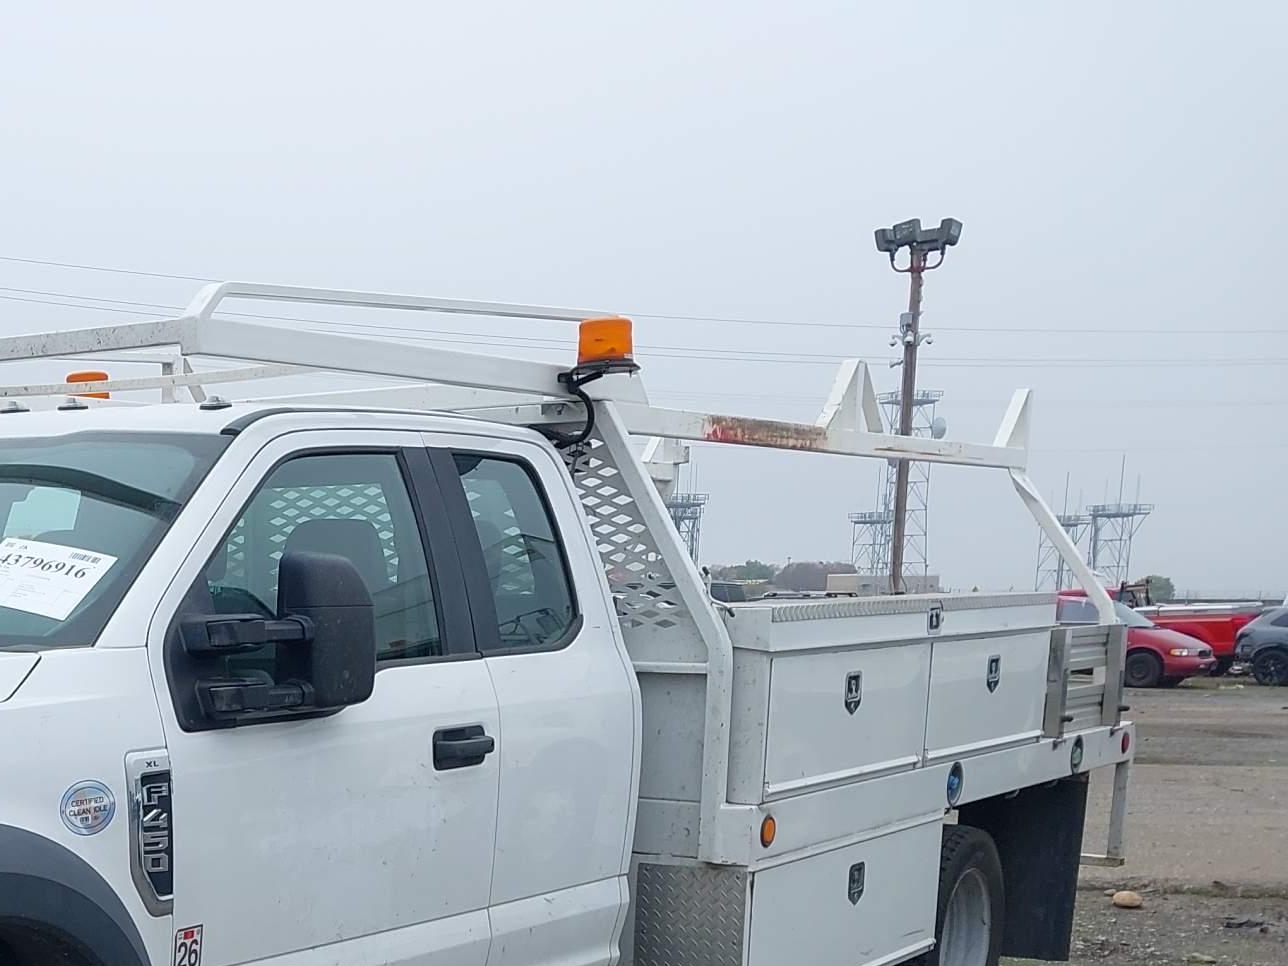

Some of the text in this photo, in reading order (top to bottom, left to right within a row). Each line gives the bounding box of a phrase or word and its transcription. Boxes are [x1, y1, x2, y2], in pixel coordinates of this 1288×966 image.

[71, 796, 104, 808] CERTIFIED
[69, 804, 108, 817] CLEAN IDLE
[142, 782, 169, 873] F450
